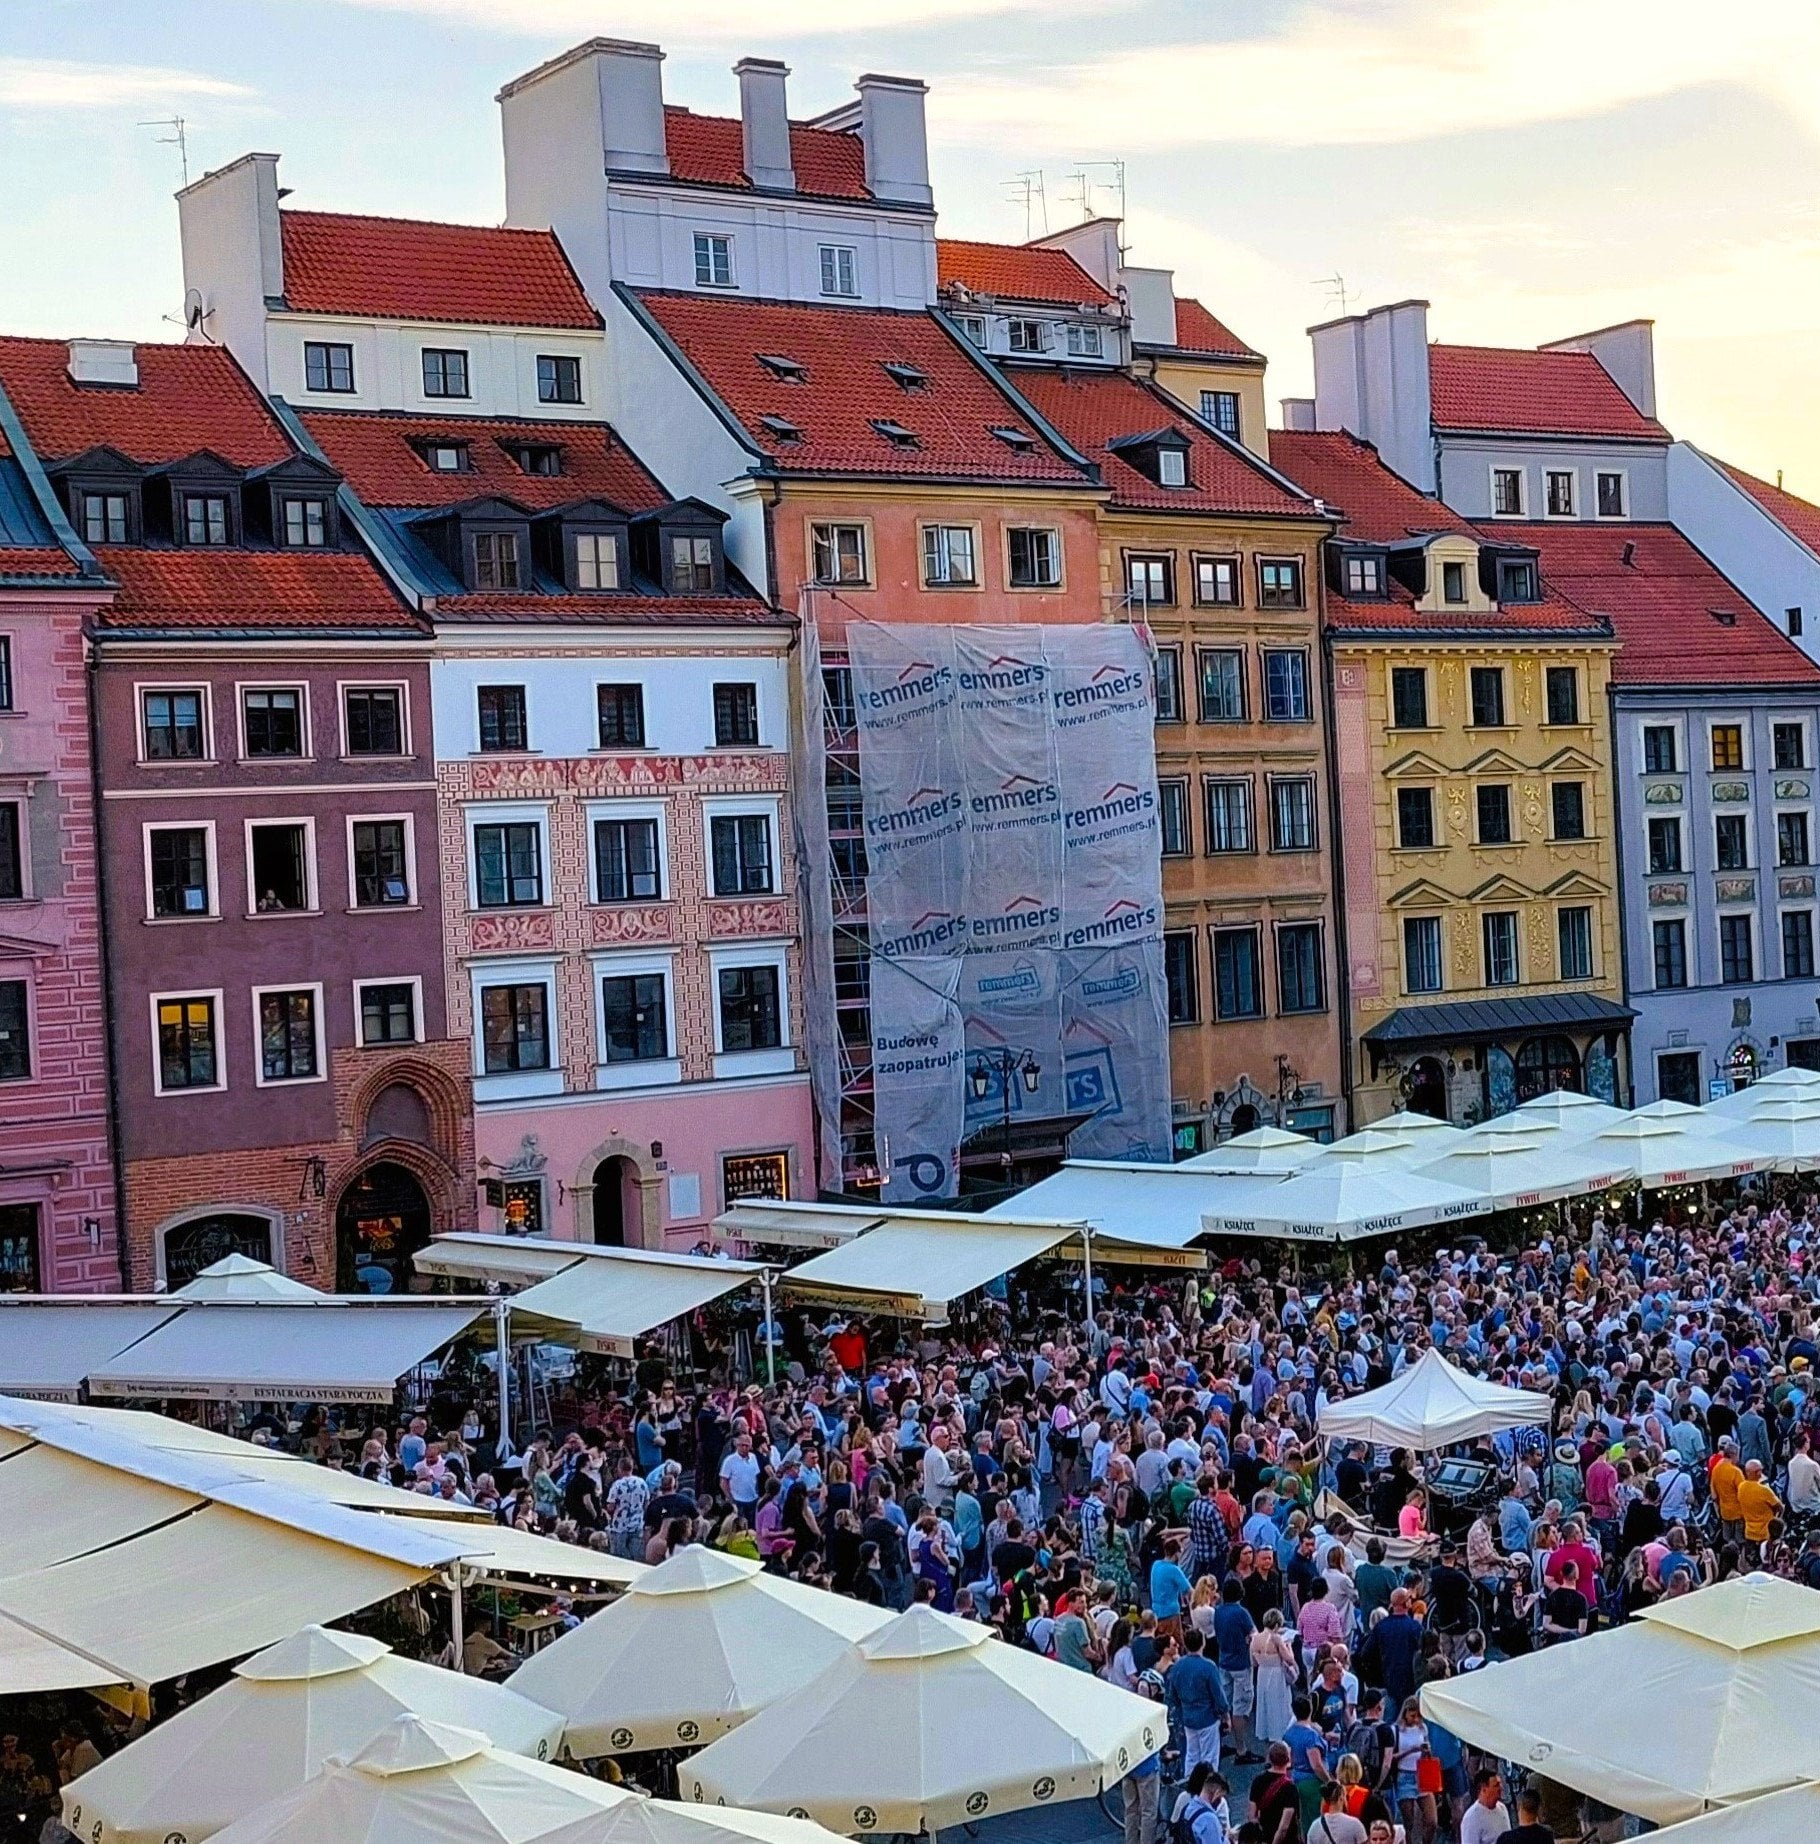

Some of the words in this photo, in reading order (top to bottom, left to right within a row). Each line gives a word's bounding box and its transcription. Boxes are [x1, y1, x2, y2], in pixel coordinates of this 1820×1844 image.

[859, 667, 951, 709] remmers
[960, 665, 1045, 689] emmers
[1054, 672, 1142, 708] remmers
[867, 792, 962, 836] remmers
[971, 785, 1056, 813] emmers
[1065, 791, 1154, 829] remmers
[874, 914, 967, 957] remmers
[973, 907, 1060, 936] emmers
[1064, 908, 1155, 948] remmers
[877, 1035, 939, 1050] Budowę
[879, 1049, 964, 1073] zaopatruje:
